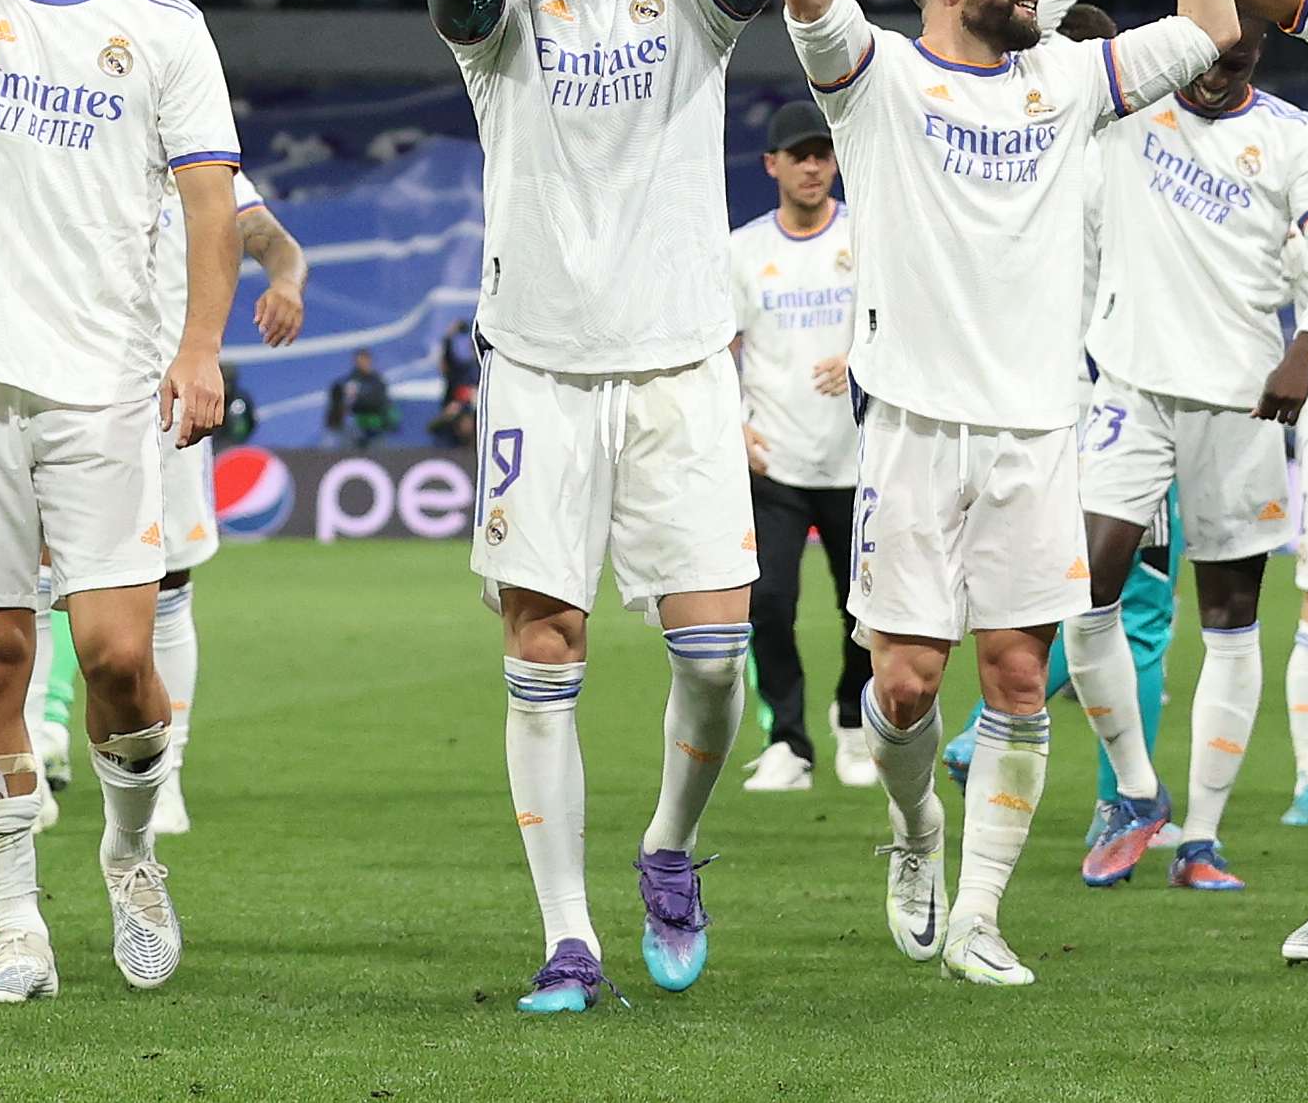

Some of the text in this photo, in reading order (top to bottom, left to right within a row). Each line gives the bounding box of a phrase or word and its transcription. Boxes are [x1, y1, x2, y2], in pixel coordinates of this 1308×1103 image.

[536, 35, 667, 77] Emirates
[552, 72, 653, 107] FLY BETTER
[28, 115, 95, 150] BETTER
[924, 113, 1056, 156] Emirates
[943, 149, 1039, 183] FLY BETTER
[1143, 131, 1252, 208] Emirates
[1172, 184, 1231, 224] BETTER
[762, 285, 854, 311] Emirates
[490, 428, 524, 498] 9
